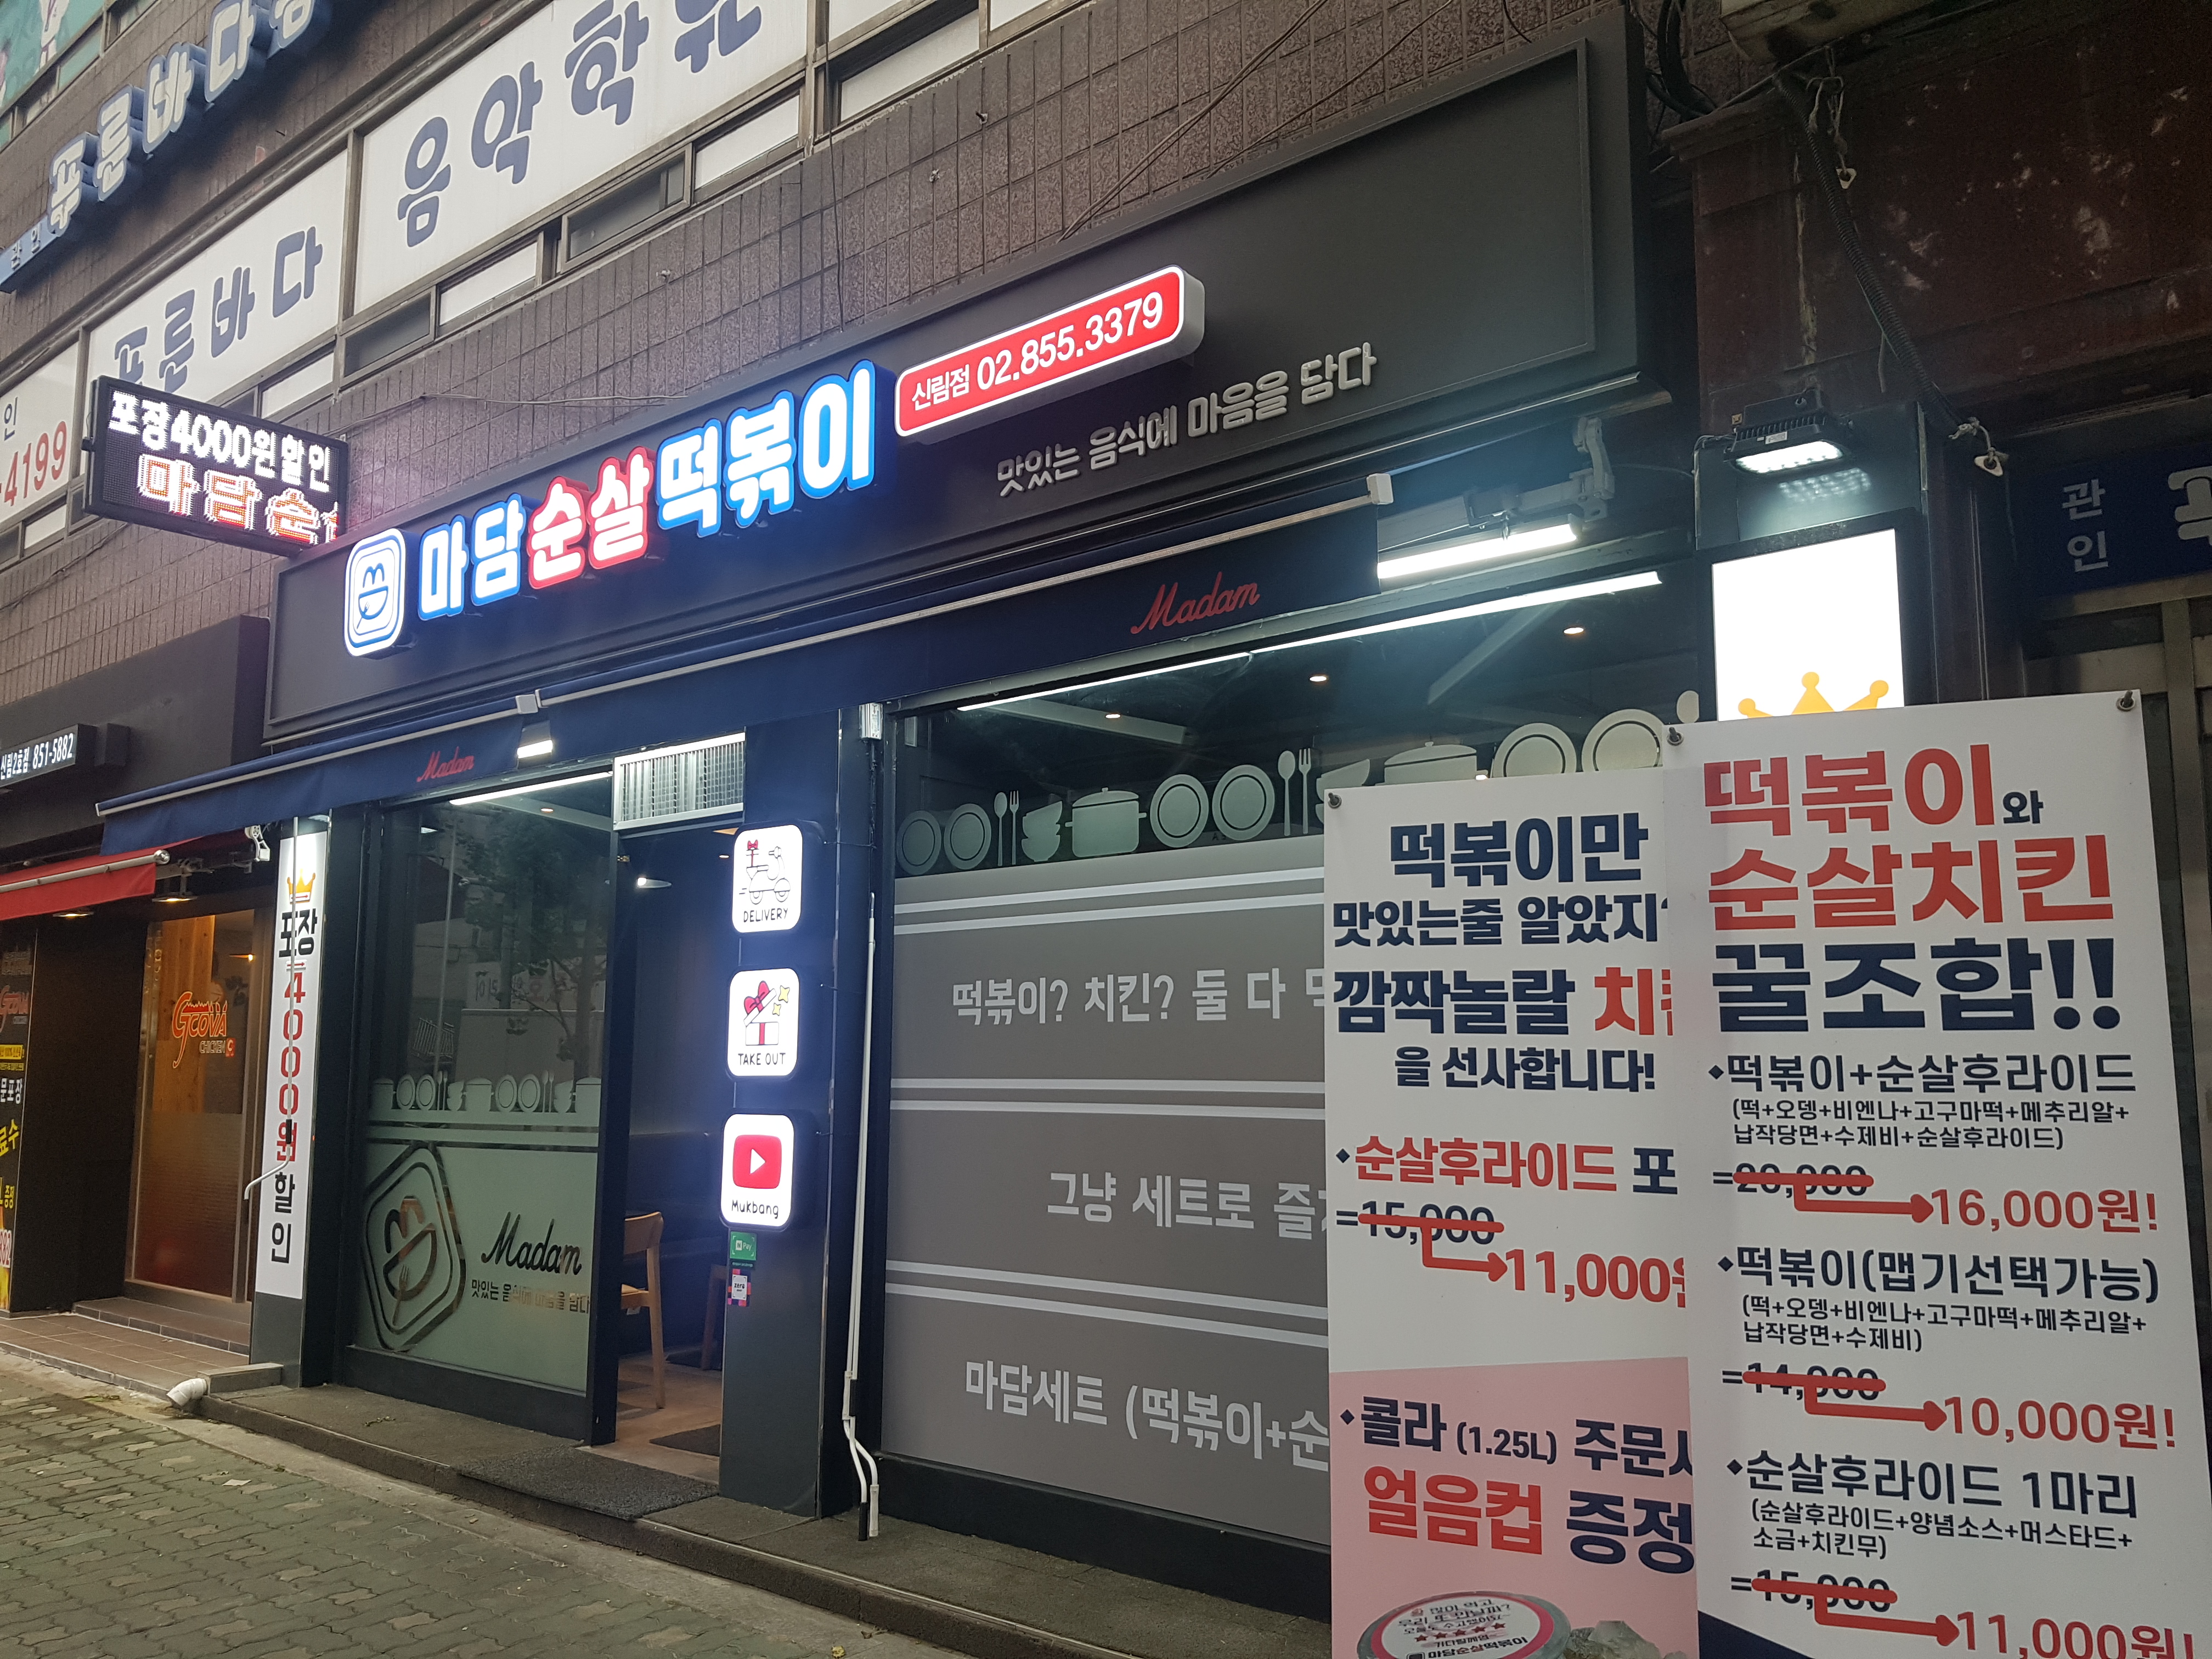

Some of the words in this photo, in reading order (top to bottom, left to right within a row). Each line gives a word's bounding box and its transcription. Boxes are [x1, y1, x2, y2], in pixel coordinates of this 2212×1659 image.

[911, 365, 971, 411] 신림점
[977, 291, 1163, 391] 02.855.3379
[997, 443, 1080, 497] 맛있는
[1088, 404, 1178, 471] 음식에
[1187, 370, 1290, 438] 마음을
[1300, 341, 1378, 405] 담다
[0, 420, 67, 507] 4199
[1130, 571, 1260, 634] Madam
[1, 747, 30, 780] 신림2호점
[32, 732, 74, 770] 851-5882
[416, 746, 475, 782] Madam
[1390, 812, 1649, 888] 떡볶이만
[1708, 834, 2114, 931] 순살치킨
[743, 907, 788, 923] DELIVERY
[1333, 898, 1503, 947] 맛있는줄
[952, 977, 1069, 1026] 떡볶이?
[1085, 973, 1175, 1023] 치킨?
[1192, 969, 1228, 1021] 둘
[1247, 967, 1286, 1019] 다
[1333, 969, 1576, 1035] 깜짝놀랄
[1712, 938, 2121, 1032] 꿀조합!!
[738, 1053, 761, 1065] TAKE
[765, 1052, 786, 1065] OUT
[1395, 1045, 1431, 1088] 을
[1442, 1046, 1655, 1092] 선사합니다!
[1726, 1053, 2136, 1093] 떡볶이+순살후라이드
[1355, 1135, 1617, 1192] 순살후라이드
[1632, 1147, 1678, 1195] 포
[732, 1199, 779, 1220] Mukbang
[1048, 1172, 1117, 1222] 그냥
[1132, 1175, 1255, 1228] 세트로
[1274, 1182, 1327, 1240] 즐
[1931, 1188, 2157, 1234] 16,000원!
[481, 1211, 582, 1276] Madam
[471, 1279, 499, 1301] 맛있는
[1737, 1246, 2159, 1304] 떡볶이(맵기선택가능)
[1743, 1321, 1922, 1352] 납작당면+수제비)
[966, 1359, 1107, 1425] 마담세트
[1361, 1396, 1447, 1452] 콜라
[1457, 1421, 1557, 1465] (1.25L)
[1944, 1396, 2176, 1449] 10,000원!
[1746, 1450, 2002, 1506] 순살후라이드
[2022, 1471, 2137, 1519] 1마리
[1364, 1465, 1543, 1555] 얼음컵
[1566, 1489, 1695, 1574] 증정
[1753, 1530, 1887, 1560] 소금+치킨무)
